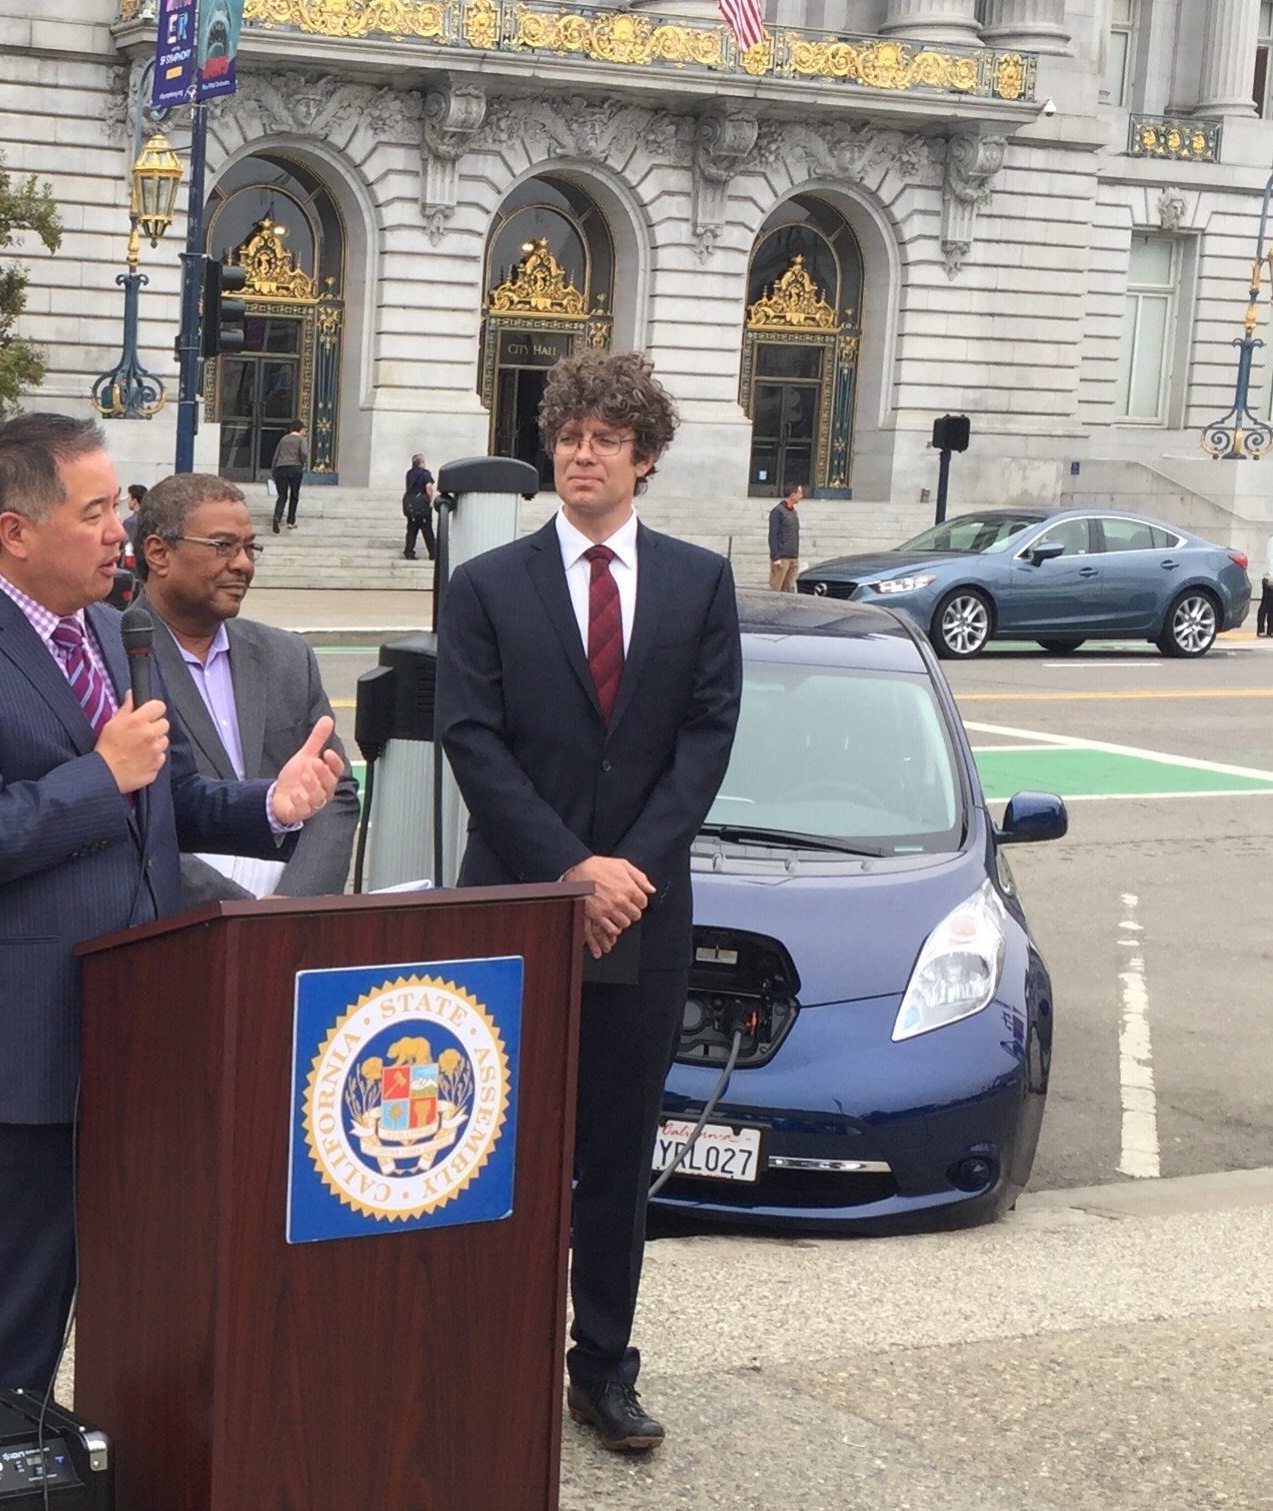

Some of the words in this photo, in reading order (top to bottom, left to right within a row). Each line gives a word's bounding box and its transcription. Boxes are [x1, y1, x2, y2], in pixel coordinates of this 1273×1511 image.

[508, 344, 529, 355] CITY
[533, 344, 557, 356] HALL
[380, 993, 469, 1026] STATE
[317, 1030, 392, 1203] CALIFORNIA
[422, 1046, 497, 1199] ASSEMBLY
[659, 1139, 753, 1176] YRL027
